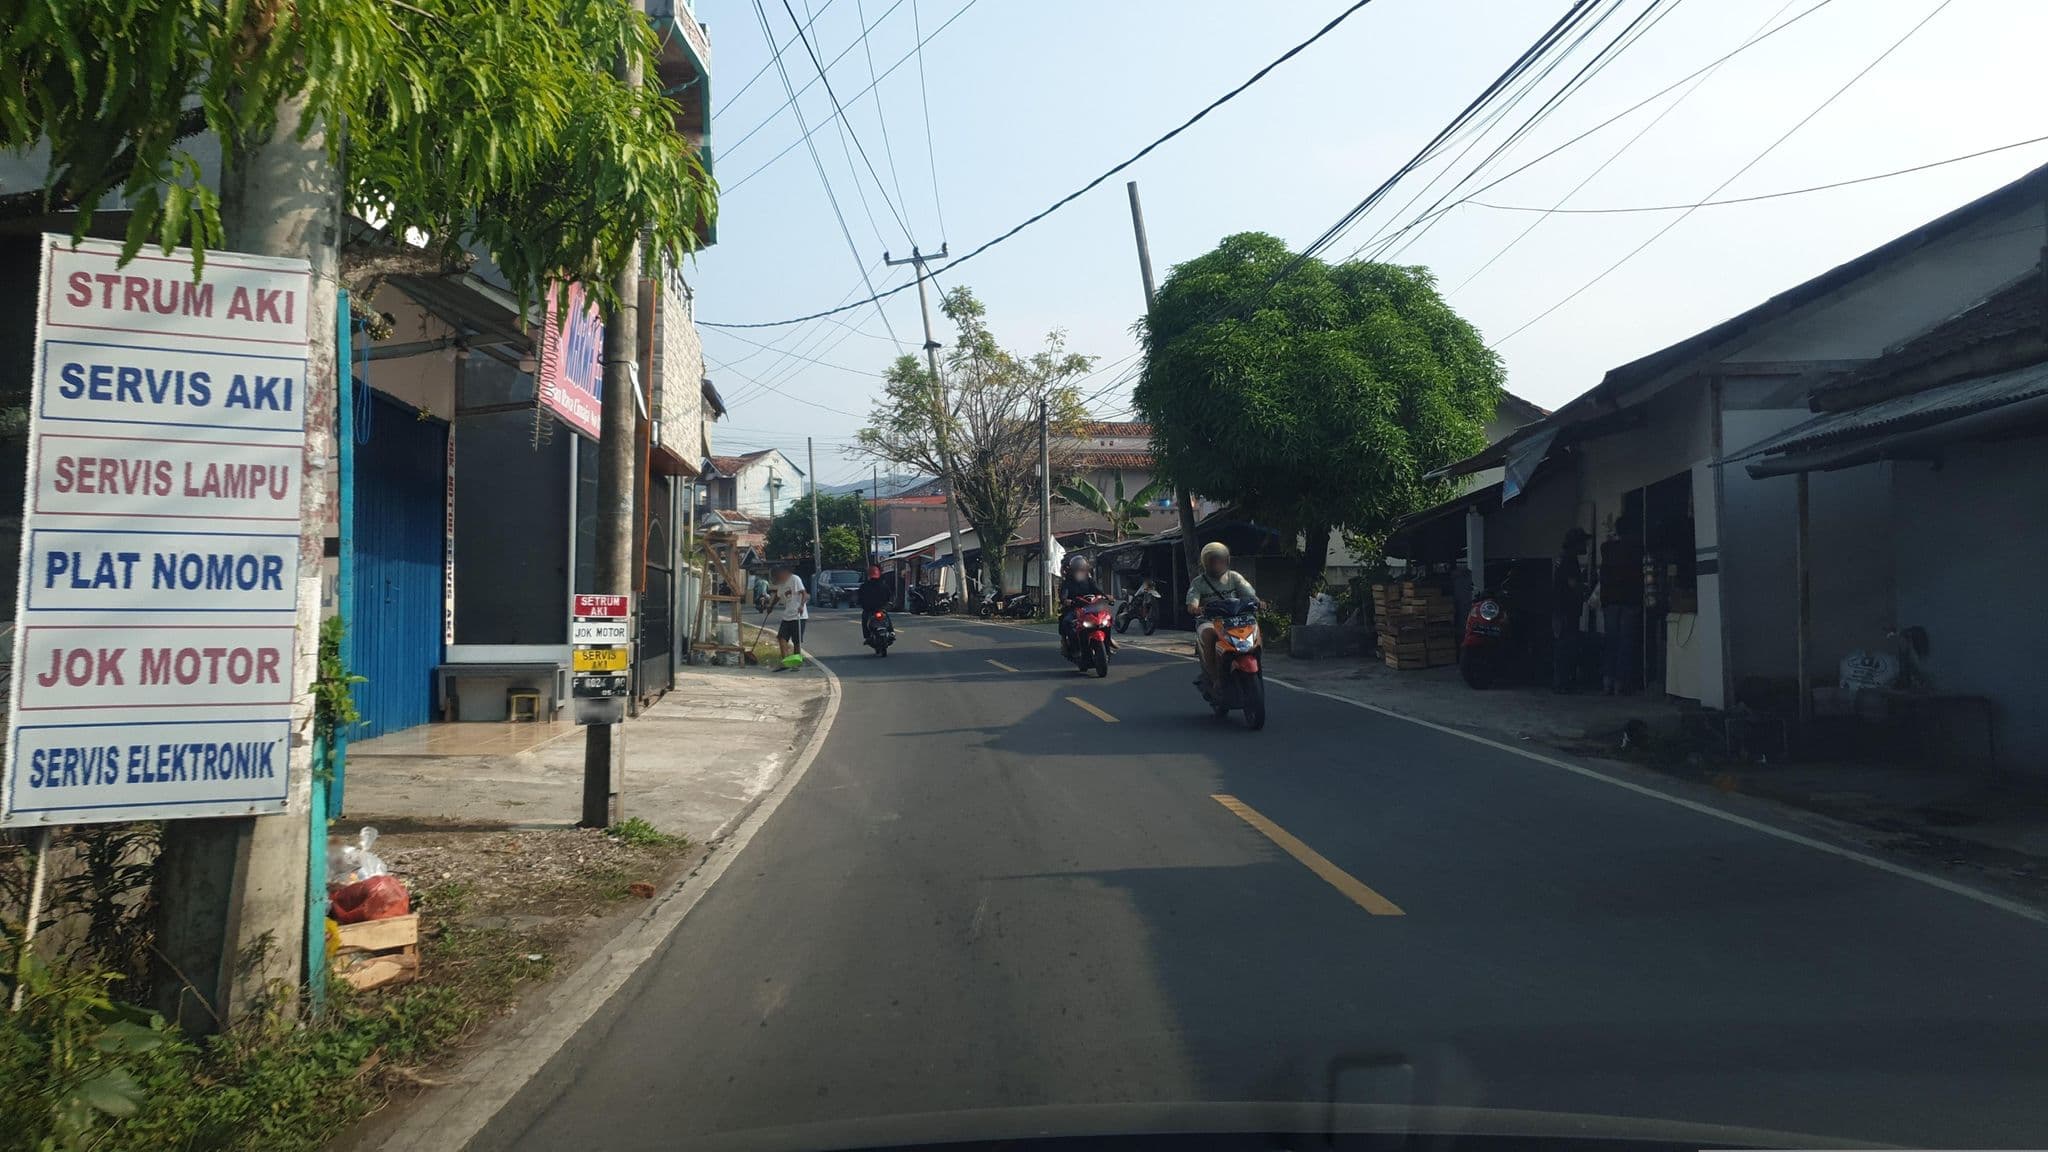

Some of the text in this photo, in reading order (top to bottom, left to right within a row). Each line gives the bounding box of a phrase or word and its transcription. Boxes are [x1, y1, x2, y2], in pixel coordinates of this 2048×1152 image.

[65, 271, 295, 324] STRUM AKI
[59, 362, 293, 411] SERVIS AKI
[54, 455, 290, 501] SERVIS LAMPU
[44, 550, 140, 590] PLAT
[152, 552, 284, 592] NOMOR
[580, 596, 620, 607] SETRUM
[590, 606, 608, 616] AKI
[575, 627, 625, 638] JOK MOTOR
[37, 647, 281, 688] JOK MOTOR
[582, 650, 617, 661] SERVIS
[29, 741, 276, 789] SERVIS ELEKTRONIK
